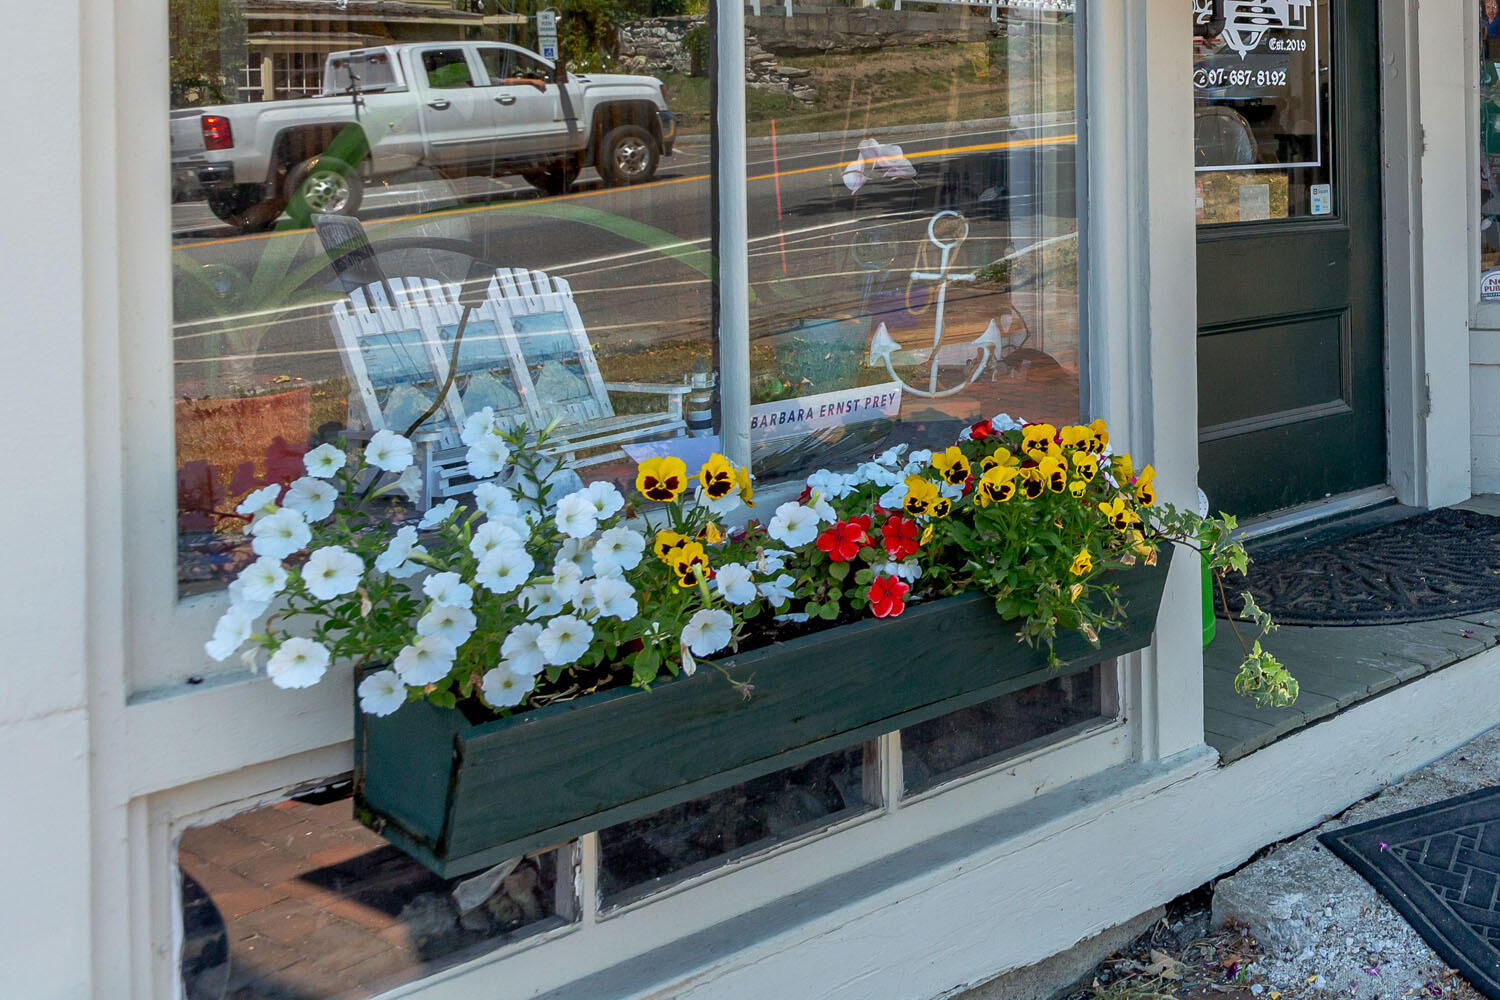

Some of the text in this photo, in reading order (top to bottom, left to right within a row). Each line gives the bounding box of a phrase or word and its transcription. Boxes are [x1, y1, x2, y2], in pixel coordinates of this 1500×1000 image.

[750, 392, 896, 430] BARBARA ERNST PREY
